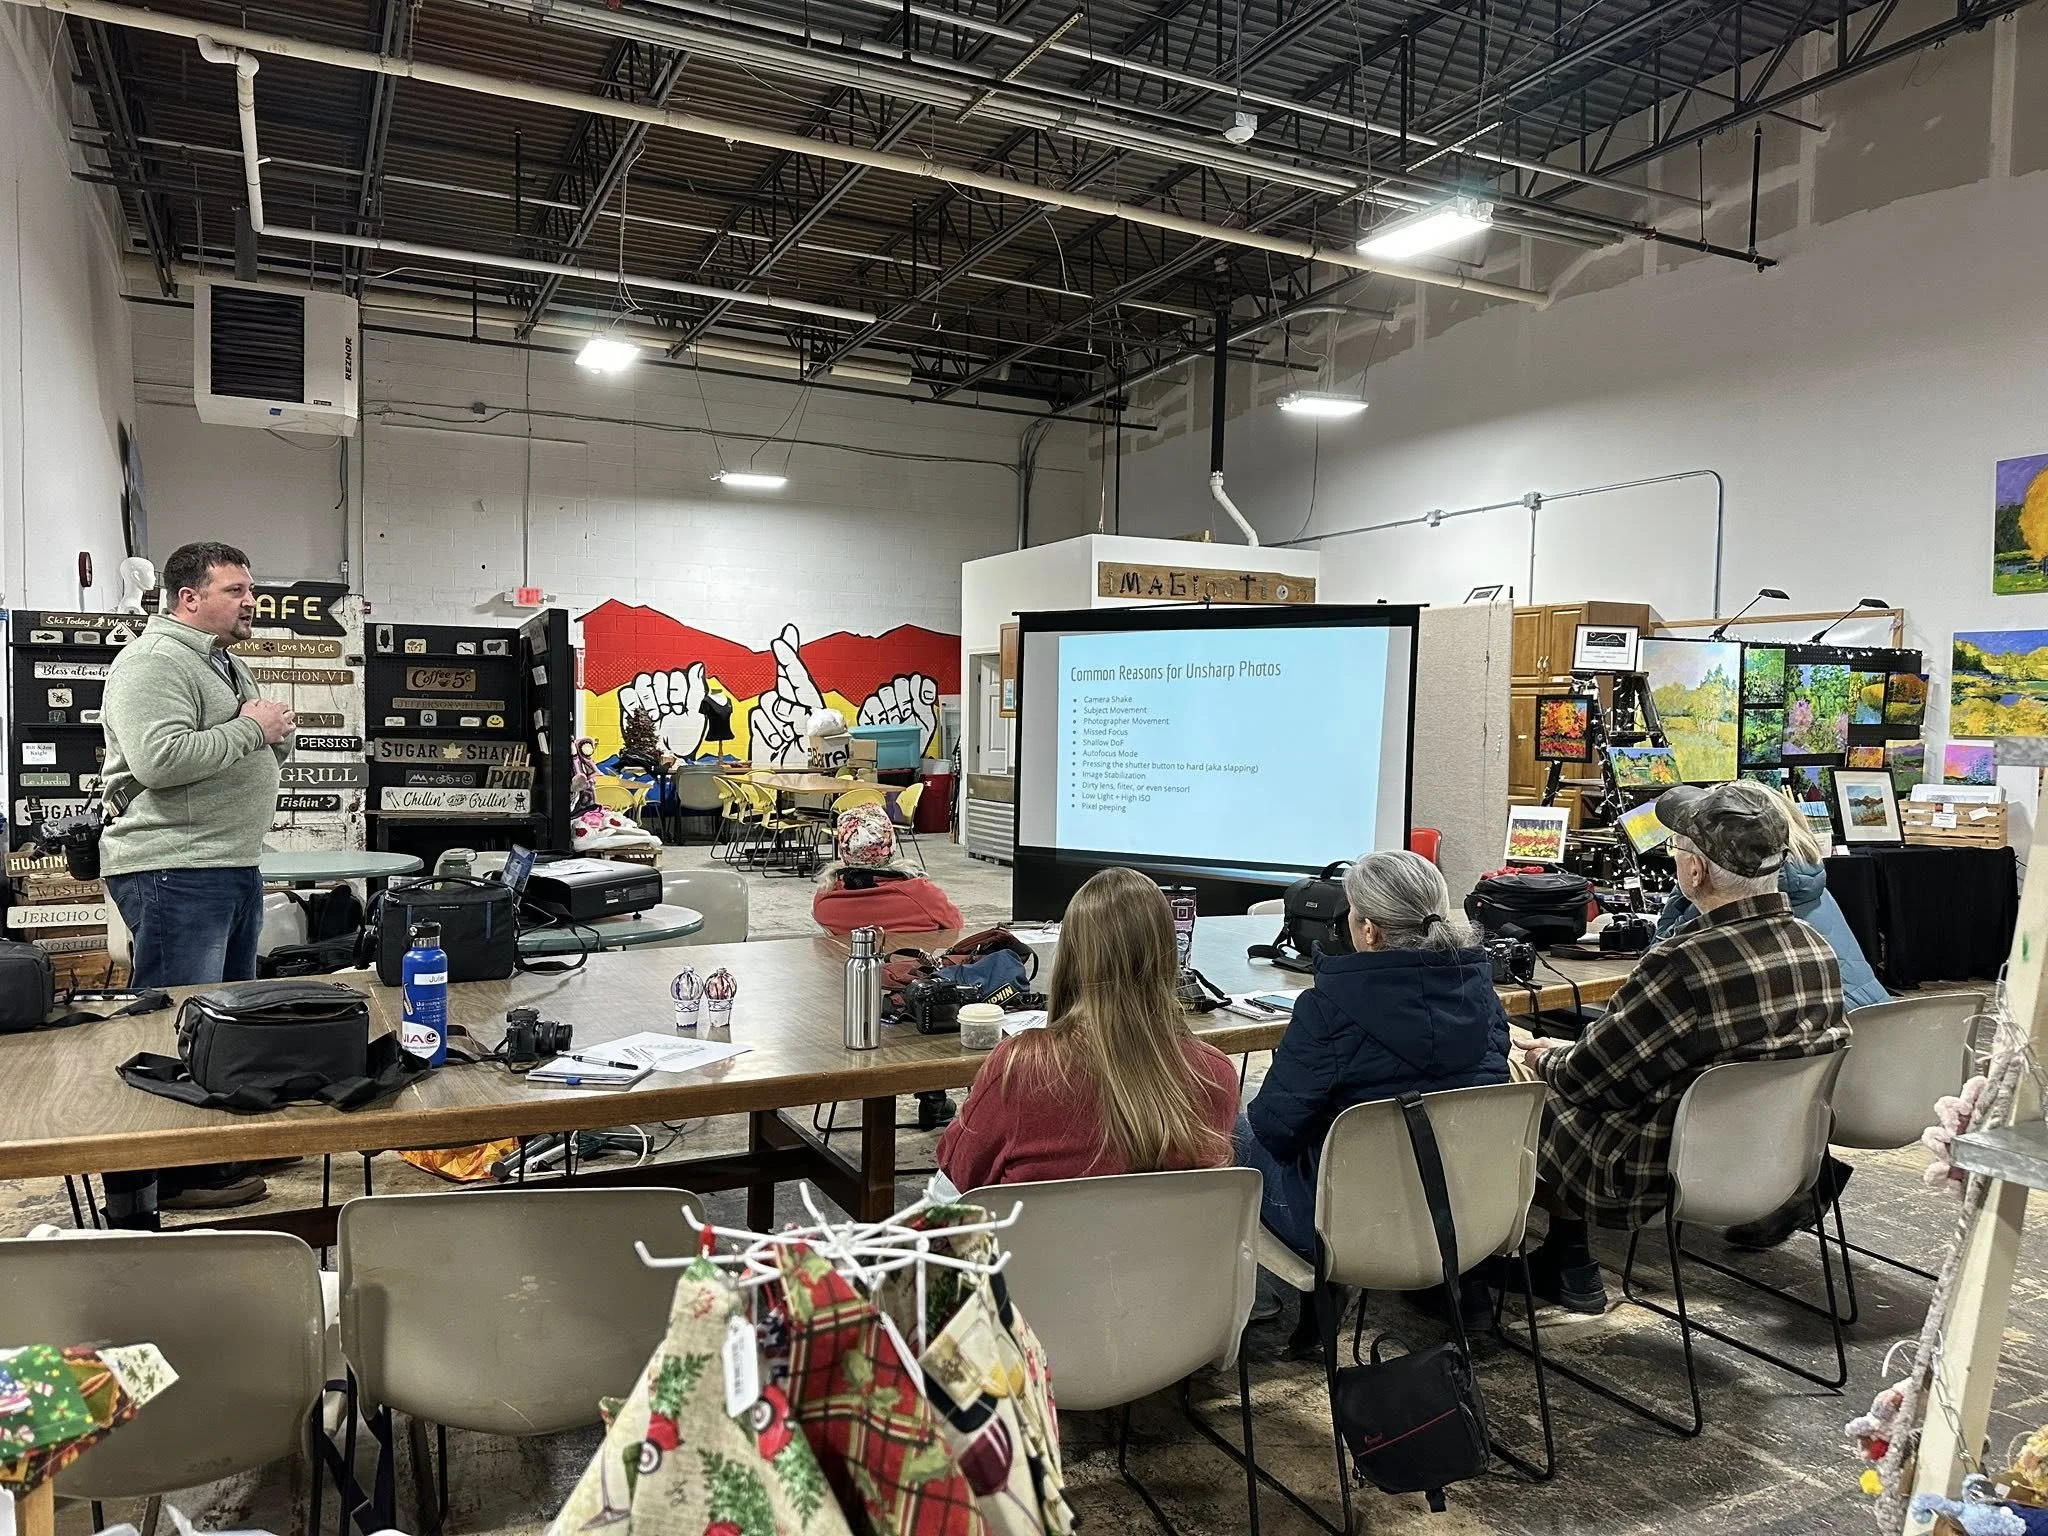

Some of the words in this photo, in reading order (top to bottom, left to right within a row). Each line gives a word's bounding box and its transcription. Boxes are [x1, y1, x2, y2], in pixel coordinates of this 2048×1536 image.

[45, 616, 64, 625] Ski
[65, 616, 91, 627] Today
[244, 642, 260, 652] Me
[277, 642, 297, 653] Love
[300, 642, 315, 654] My
[318, 643, 334, 654] Cat
[41, 664, 66, 675] Bless
[1070, 666, 1116, 682] Common
[1119, 665, 1164, 680] Reasons
[1166, 664, 1182, 683] for
[1186, 662, 1235, 681] Unsharp
[1239, 660, 1282, 677] Photos
[326, 672, 346, 682] VT
[412, 670, 451, 688] Coffee
[1084, 696, 1110, 704] Camera
[1112, 694, 1133, 703] Shake
[1084, 706, 1108, 716] Subject
[1110, 706, 1148, 714] Movement
[319, 715, 338, 725] VT
[1084, 717, 1130, 726] Photographer
[1132, 717, 1170, 725] Movement
[1084, 728, 1106, 736] Missed
[1108, 728, 1128, 736] Focus
[299, 737, 358, 748] PERSIST
[381, 742, 438, 758] SUGAR
[1082, 750, 1116, 758] Autofocus
[1118, 750, 1138, 758] Mode
[1082, 760, 1111, 770] Pressing
[1206, 764, 1222, 772] (aka
[1223, 764, 1259, 774] slapping)
[280, 767, 358, 784] GRILL
[1082, 771, 1103, 780] Image
[1104, 772, 1146, 780] Stabilization
[23, 776, 34, 786] Le
[36, 776, 68, 786] Jardin
[1082, 782, 1098, 790] Dirty
[1100, 782, 1116, 790] lens,
[1116, 782, 1135, 792] filter,
[1097, 792, 1114, 801] Light
[1121, 794, 1138, 802] High
[1099, 804, 1127, 813] peeping
[17, 910, 90, 924] JERICHO
